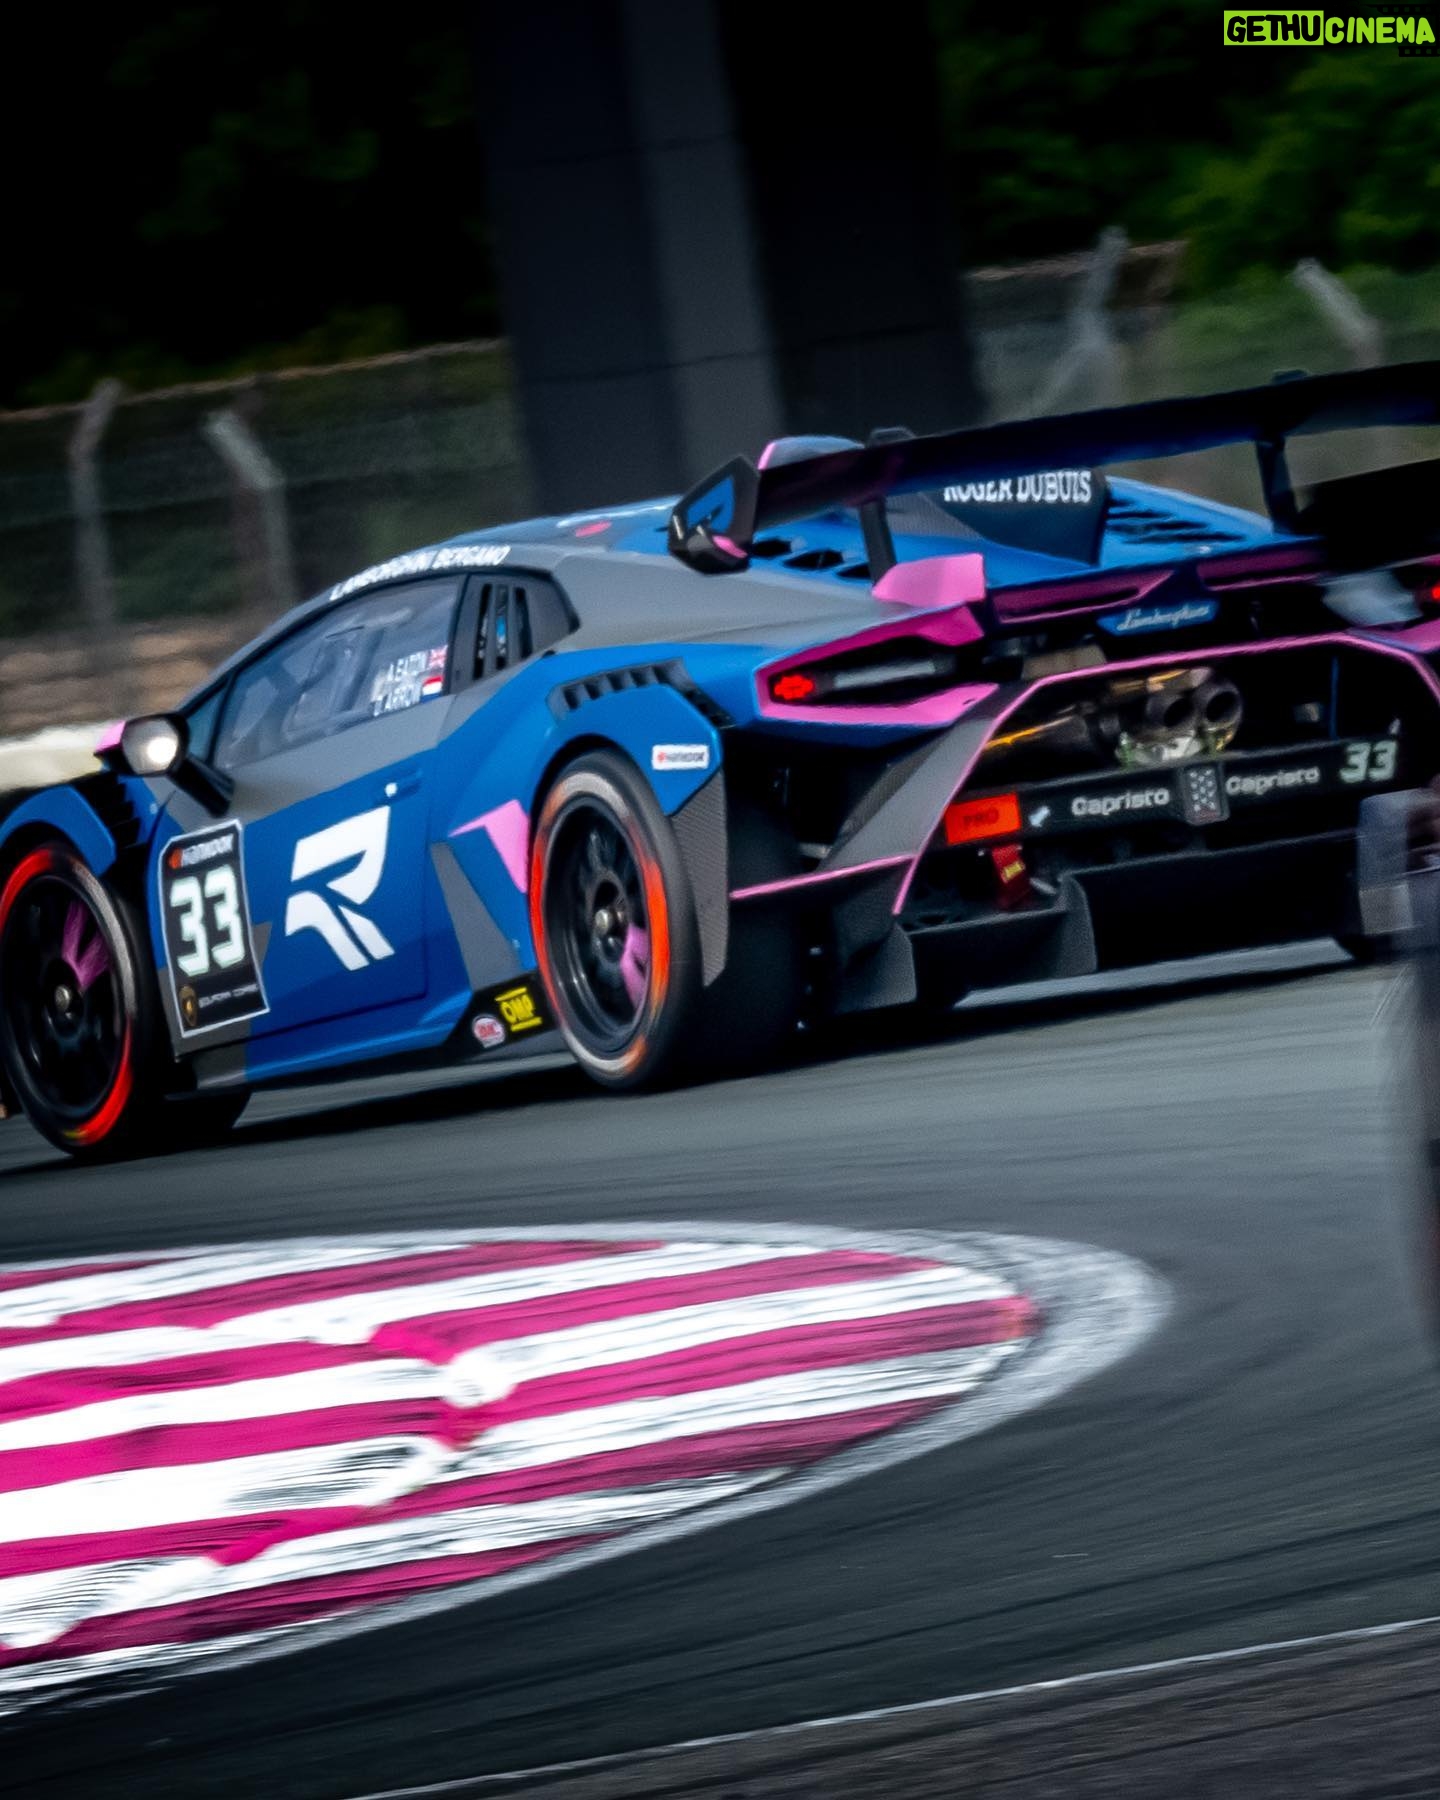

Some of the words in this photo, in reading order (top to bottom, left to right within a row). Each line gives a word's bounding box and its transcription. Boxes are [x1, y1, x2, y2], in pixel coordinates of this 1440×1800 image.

[1016, 470, 1091, 503] DUBUIS
[431, 544, 511, 570] BERGAMO
[1340, 740, 1397, 783] 33
[1225, 766, 1321, 797] Capristo
[1071, 787, 1170, 817] Capristo
[962, 807, 1000, 832] PRO
[170, 864, 245, 977] 33
[500, 993, 534, 1025] OMP
